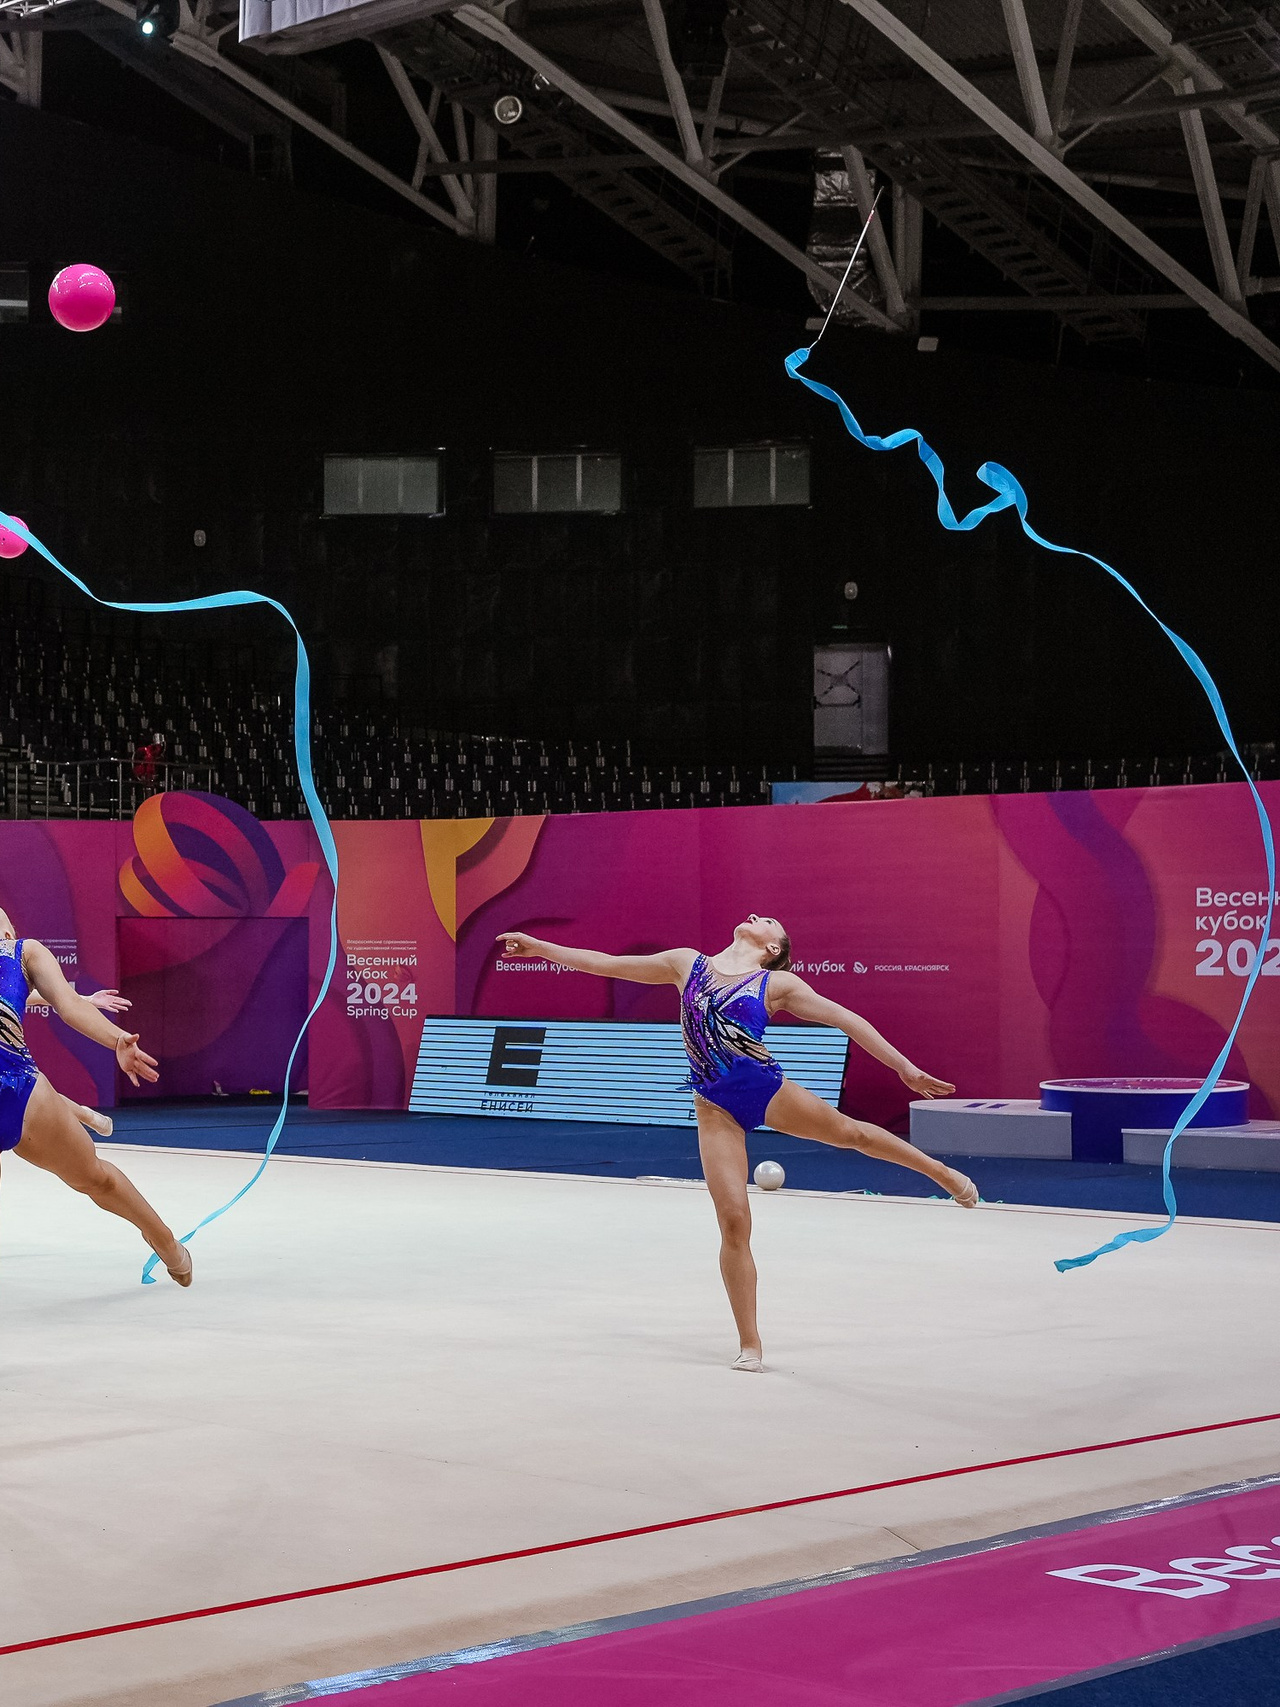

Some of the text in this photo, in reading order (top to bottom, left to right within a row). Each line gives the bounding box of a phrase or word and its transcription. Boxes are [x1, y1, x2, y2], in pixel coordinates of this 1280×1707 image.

[1195, 909, 1269, 936] кубок
[346, 953, 418, 967] Весенний
[496, 960, 548, 972] Весенний
[346, 967, 389, 983] кубок
[807, 960, 846, 976] кубок
[904, 964, 950, 972] КРАСНОЯРСК
[346, 982, 418, 1005] 2024
[25, 1003, 49, 1017] ring
[346, 1005, 418, 1020] Spring Cup
[484, 1026, 547, 1086] Е
